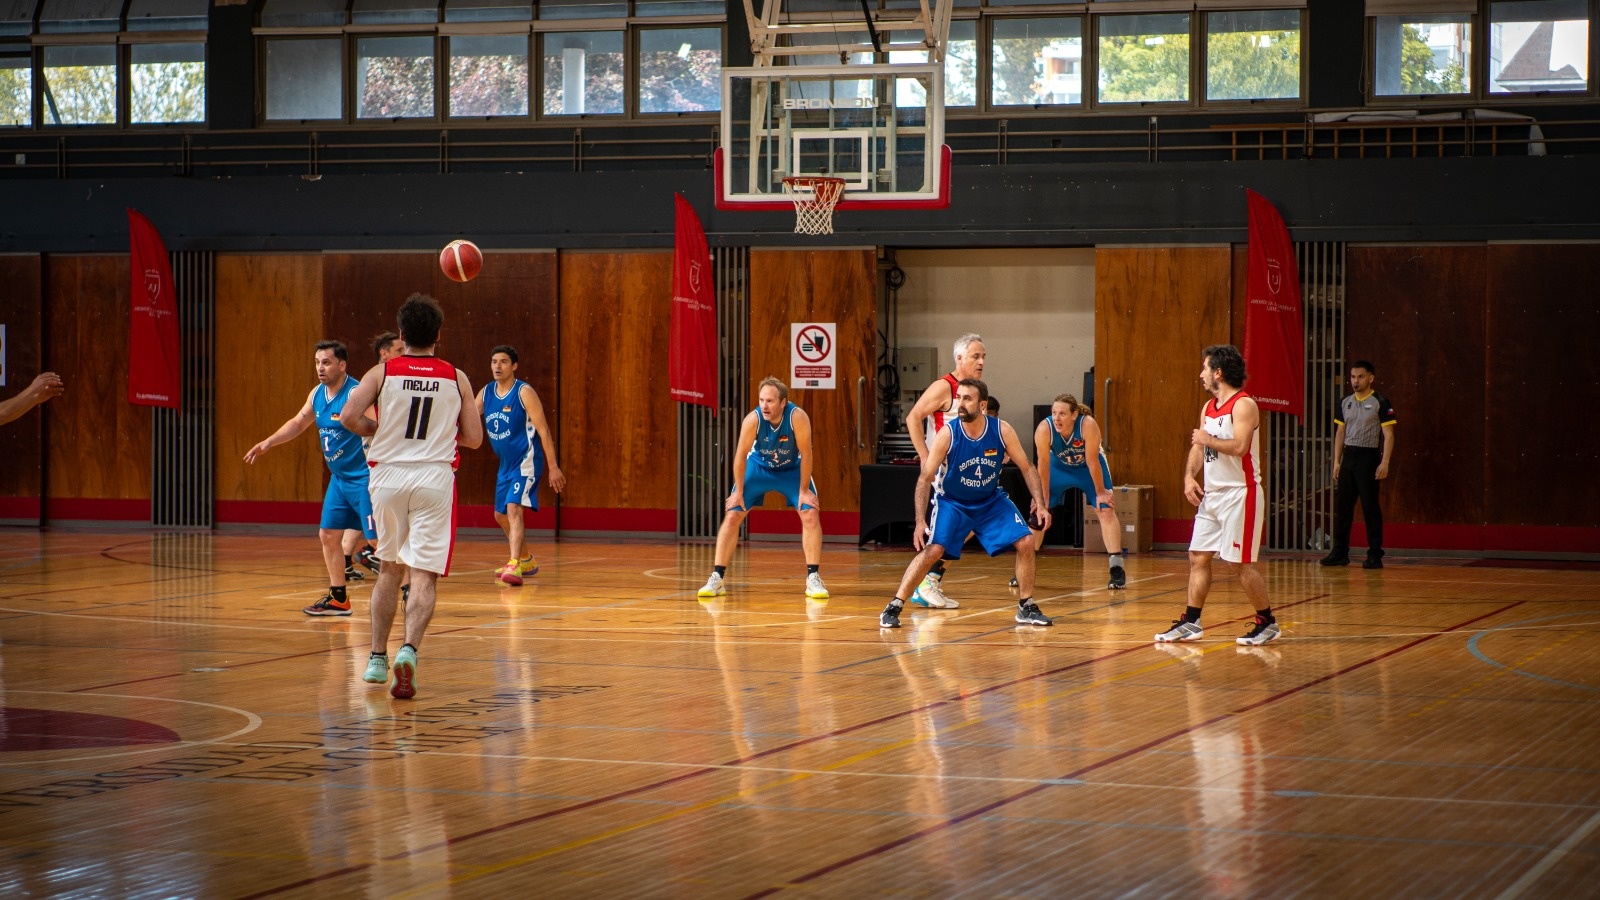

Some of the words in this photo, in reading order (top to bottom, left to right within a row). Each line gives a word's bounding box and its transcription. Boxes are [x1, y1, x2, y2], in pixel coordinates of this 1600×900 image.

[783, 97, 879, 109] BRONSON
[402, 379, 440, 392] MELLA
[404, 395, 434, 440] 11
[493, 419, 499, 432] 9
[322, 436, 332, 452] 1
[959, 456, 980, 471] DEUTSCHE
[980, 457, 997, 468] SCHULE
[1065, 454, 1084, 464] 12
[960, 476, 981, 487] PUERTO
[981, 471, 996, 486] VARAS
[974, 465, 983, 479] 4
[513, 482, 520, 494] 9
[1014, 512, 1024, 526] 4
